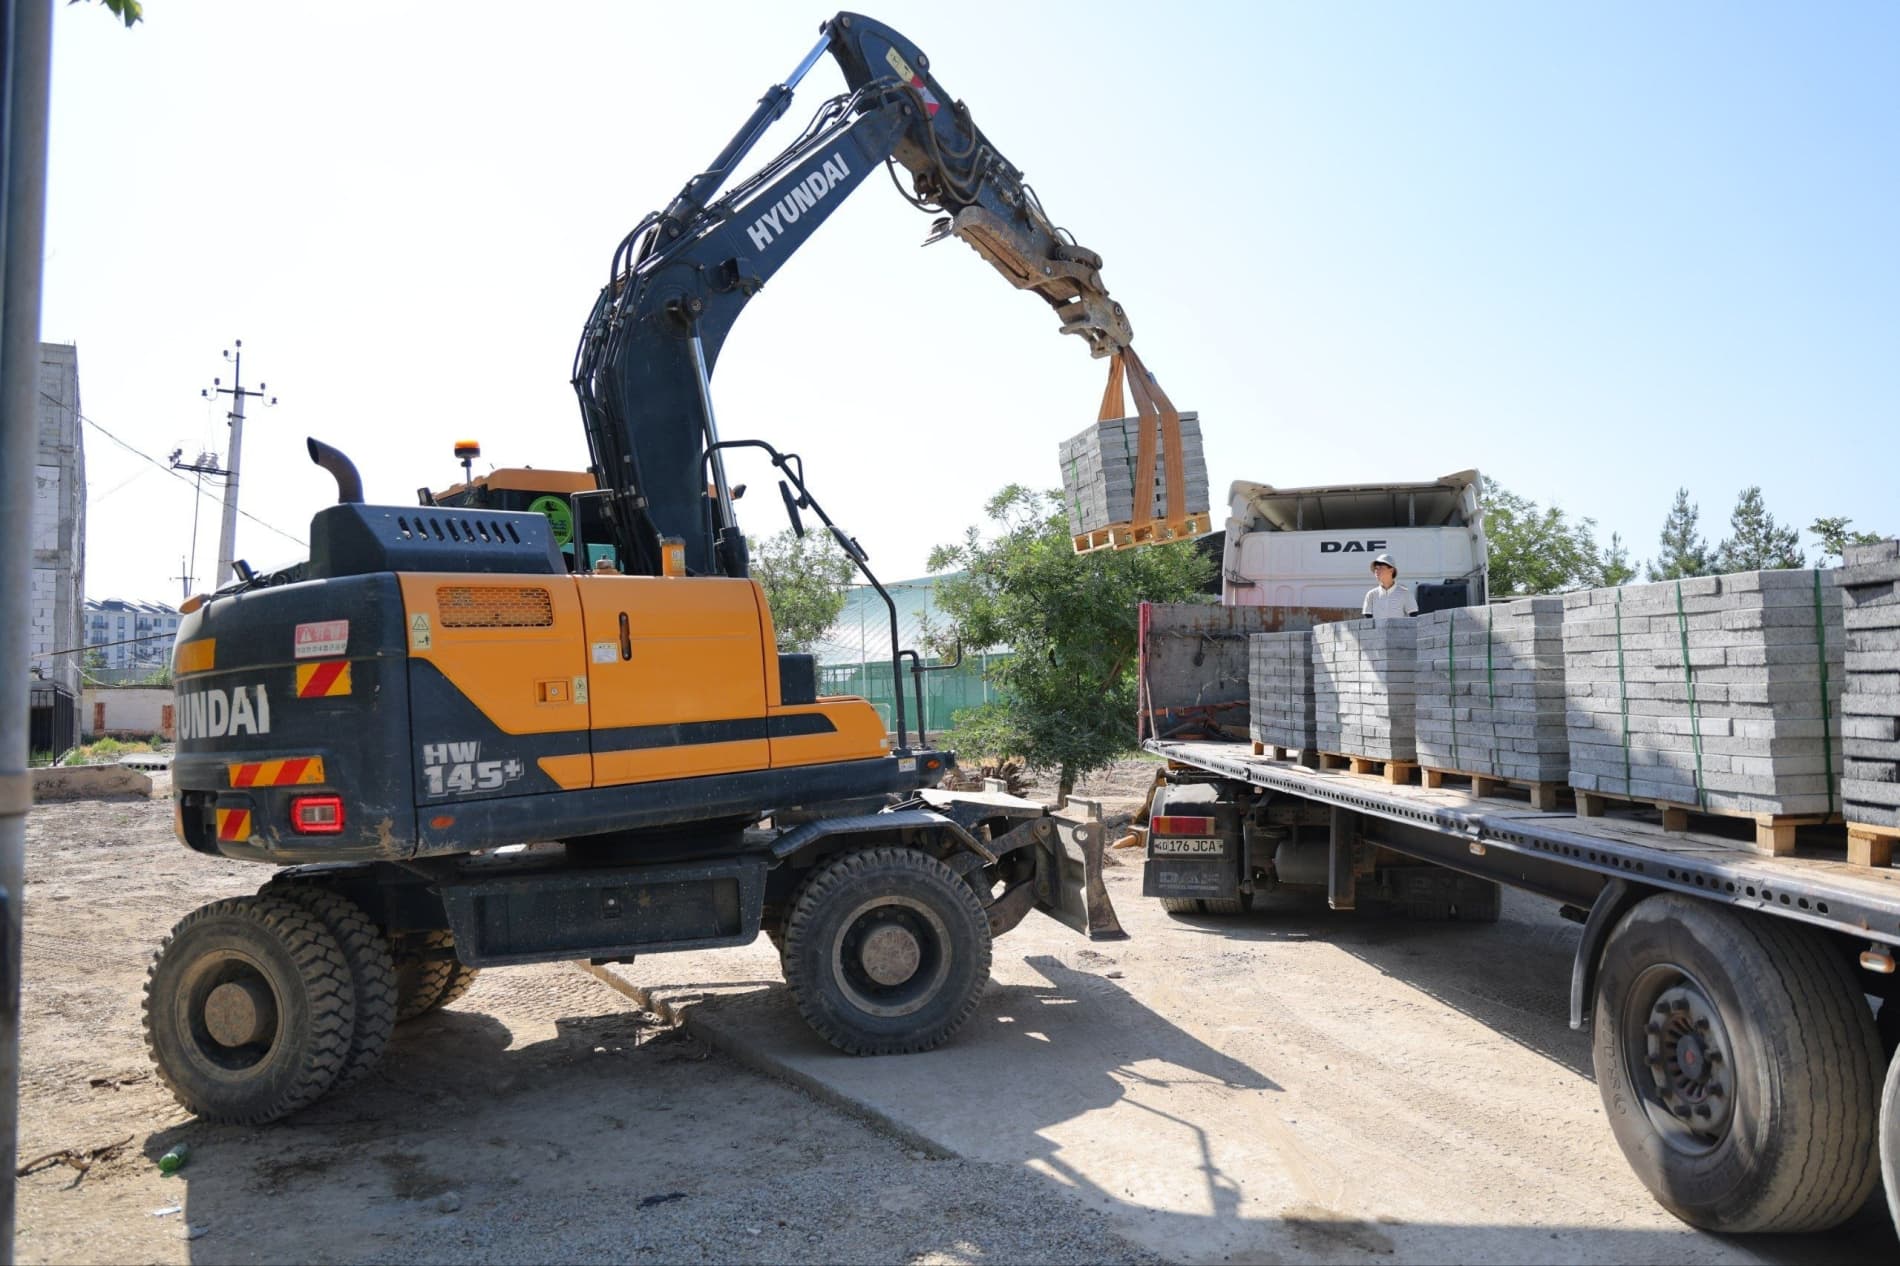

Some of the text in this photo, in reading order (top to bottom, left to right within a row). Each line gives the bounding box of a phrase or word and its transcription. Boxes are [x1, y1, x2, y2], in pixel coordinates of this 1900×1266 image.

[746, 152, 850, 252] HYUNDAI
[1320, 540, 1387, 553] DAF
[423, 741, 478, 766] HW
[424, 760, 522, 794] 145+
[1169, 840, 1190, 852] 176
[1192, 840, 1216, 852] JCA
